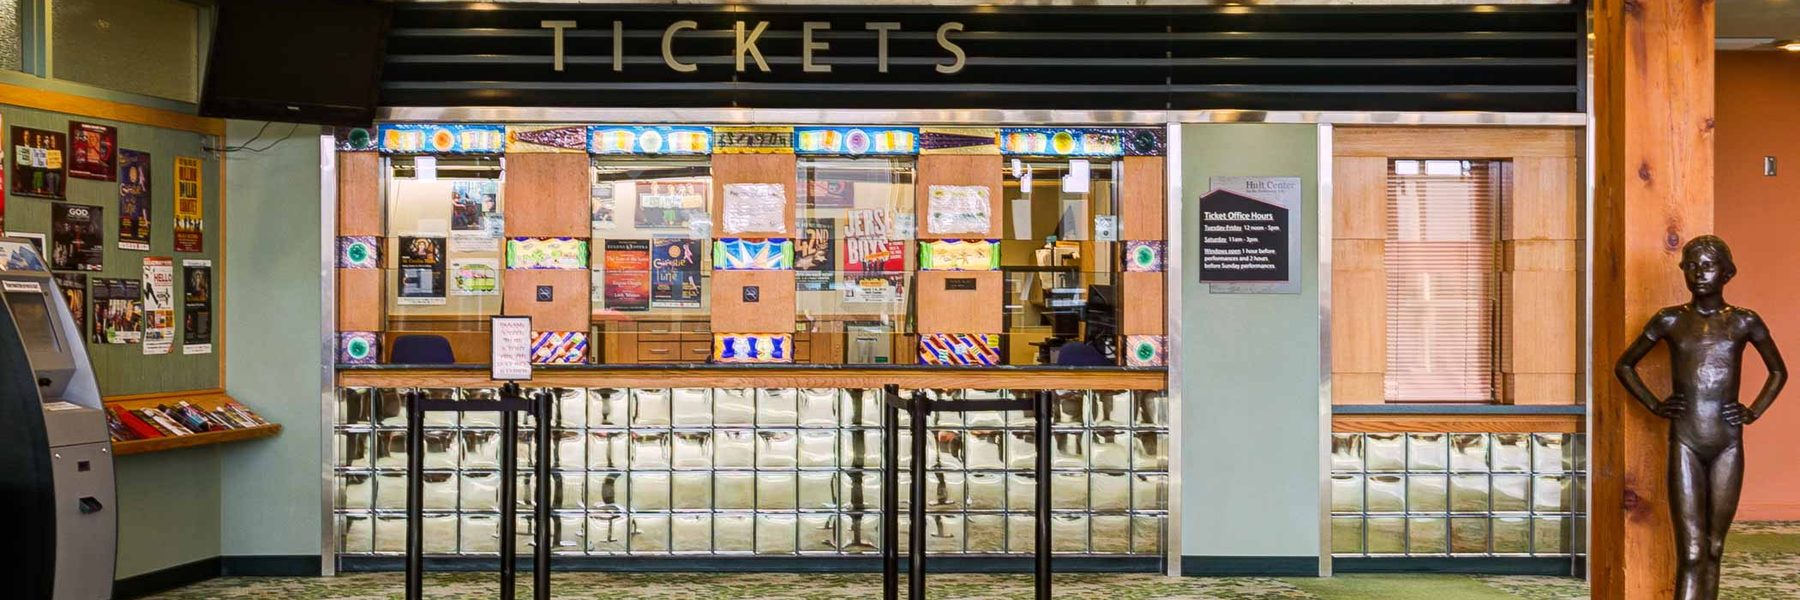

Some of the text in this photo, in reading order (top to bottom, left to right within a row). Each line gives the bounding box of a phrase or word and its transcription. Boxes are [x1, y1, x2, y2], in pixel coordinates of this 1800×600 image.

[541, 20, 966, 74] TICKETS
[1246, 181, 1296, 190] Hult Center
[69, 208, 88, 216] GOD
[1204, 212, 1274, 220] Ticket Office Hours
